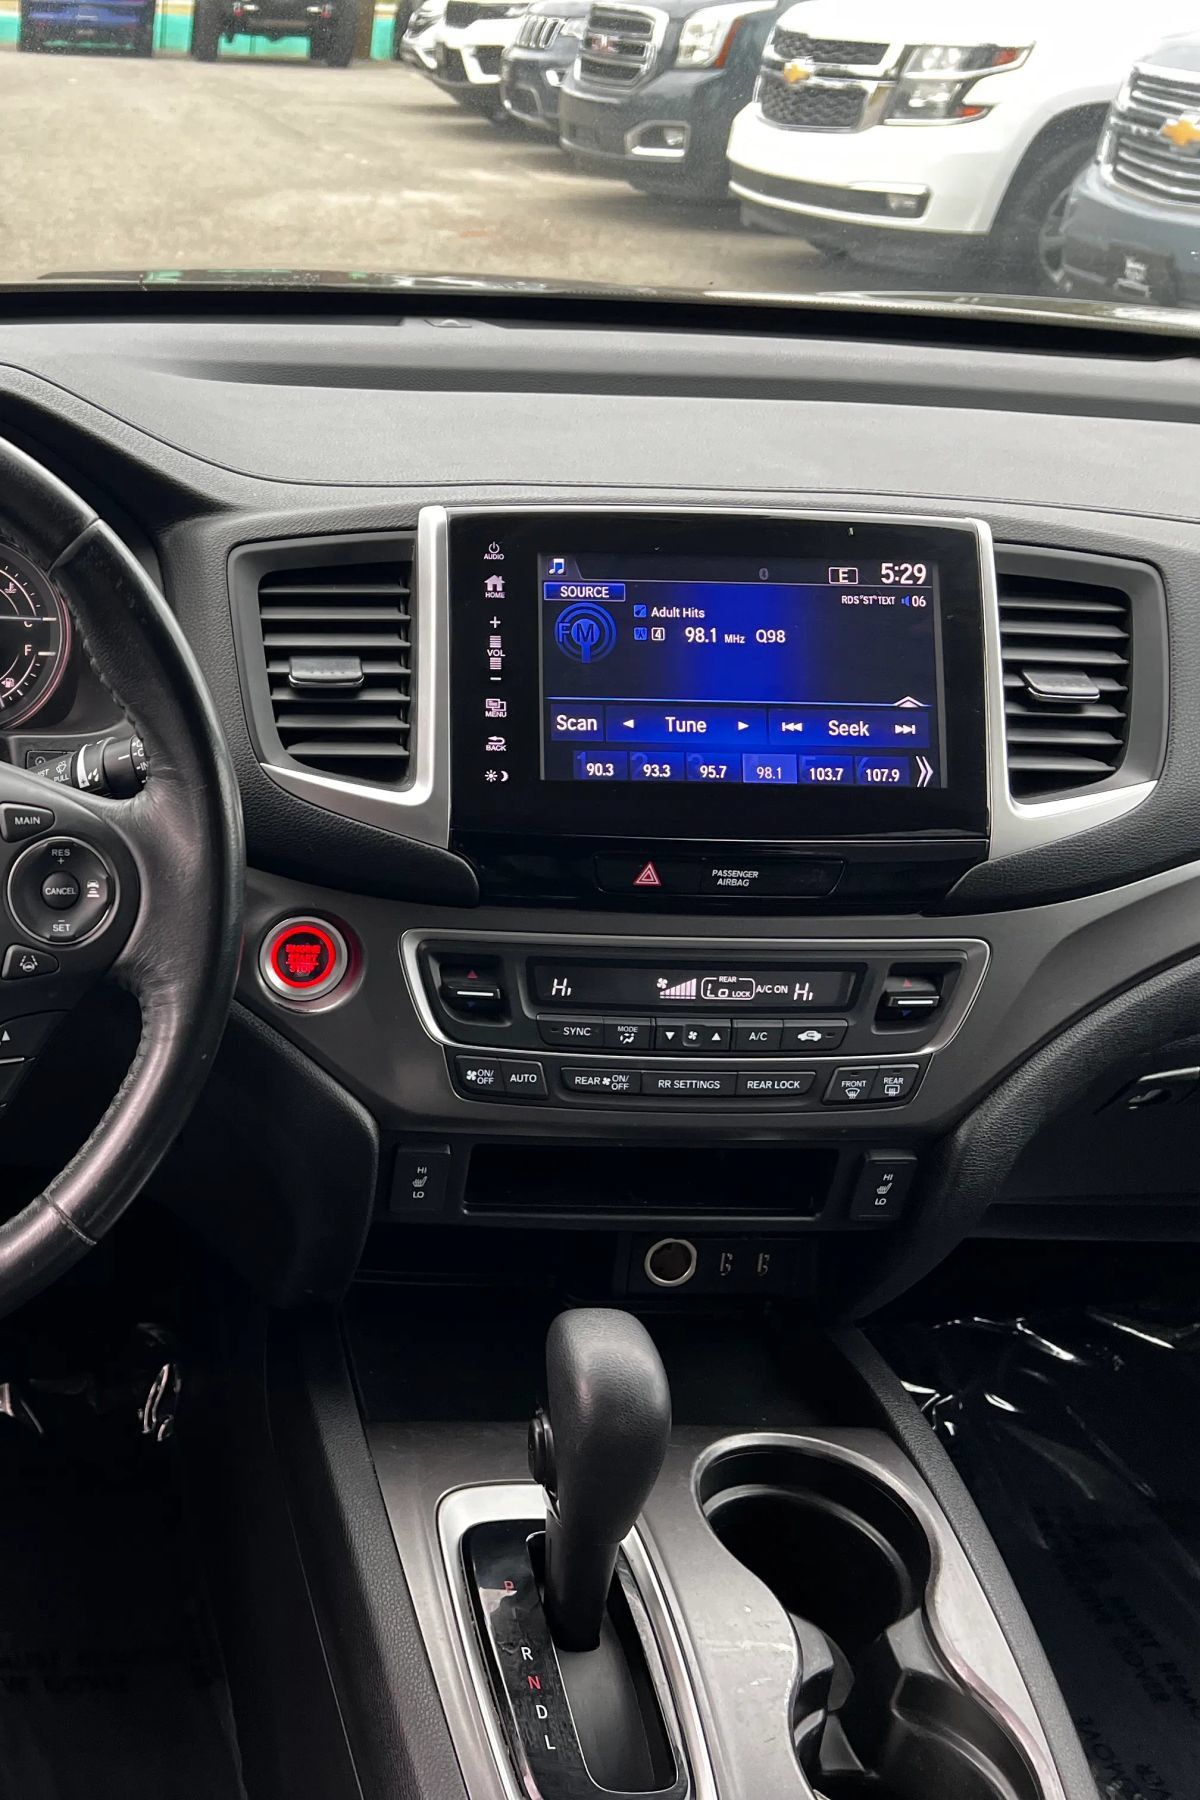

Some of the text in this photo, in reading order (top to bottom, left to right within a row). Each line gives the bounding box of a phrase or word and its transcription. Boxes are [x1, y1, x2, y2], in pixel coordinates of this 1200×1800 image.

[839, 562, 927, 585] E 5:29
[485, 591, 506, 599] HOME
[560, 586, 610, 598] SOURCE
[841, 595, 860, 605] RDS
[878, 597, 896, 605] TEXT
[911, 595, 927, 607] 06
[651, 606, 706, 618] Adult Hits
[684, 626, 717, 643] 98.1
[724, 634, 746, 644] MHz
[755, 629, 786, 644] Q98
[24, 644, 32, 656] F
[487, 649, 506, 657] VOL
[556, 714, 870, 738] Scan Tune Seek
[485, 744, 507, 752] BACK
[586, 763, 615, 777] 90.3
[642, 764, 671, 778] 93.3
[699, 765, 727, 779] 95.7
[756, 766, 782, 780] 98.1
[809, 767, 844, 782] 103.7
[865, 768, 900, 782] 107.9
[14, 816, 41, 826] MAIN
[51, 848, 71, 858] RES
[712, 869, 759, 879] PASSENGER
[717, 878, 750, 887] AIRBAG
[45, 886, 76, 896] CANCEL
[52, 923, 71, 932] SET
[718, 975, 737, 983] REAR
[732, 990, 751, 998] LOCK
[756, 984, 789, 995] A/C ON
[563, 1026, 592, 1036] SYNC
[617, 1025, 639, 1033] MODE
[748, 1031, 768, 1041] A/C
[477, 1069, 495, 1077] ON/
[509, 1073, 537, 1083] AUTO
[477, 1077, 494, 1085] OFF
[574, 1076, 601, 1086] REAR
[611, 1074, 630, 1083] ON/
[883, 1077, 904, 1085] REAR
[611, 1082, 629, 1091] OFF
[658, 1079, 721, 1089] RR SETTINGS
[746, 1080, 801, 1089] REAR LOCK
[841, 1080, 867, 1088] FRONT
[417, 1166, 427, 1174] HI
[882, 1173, 893, 1182] HI
[412, 1190, 424, 1199] LO
[874, 1197, 887, 1206] LO
[503, 1580, 515, 1593] P
[520, 1646, 534, 1661] R
[527, 1675, 542, 1690] N
[535, 1704, 549, 1720] D
[544, 1734, 557, 1750] L
